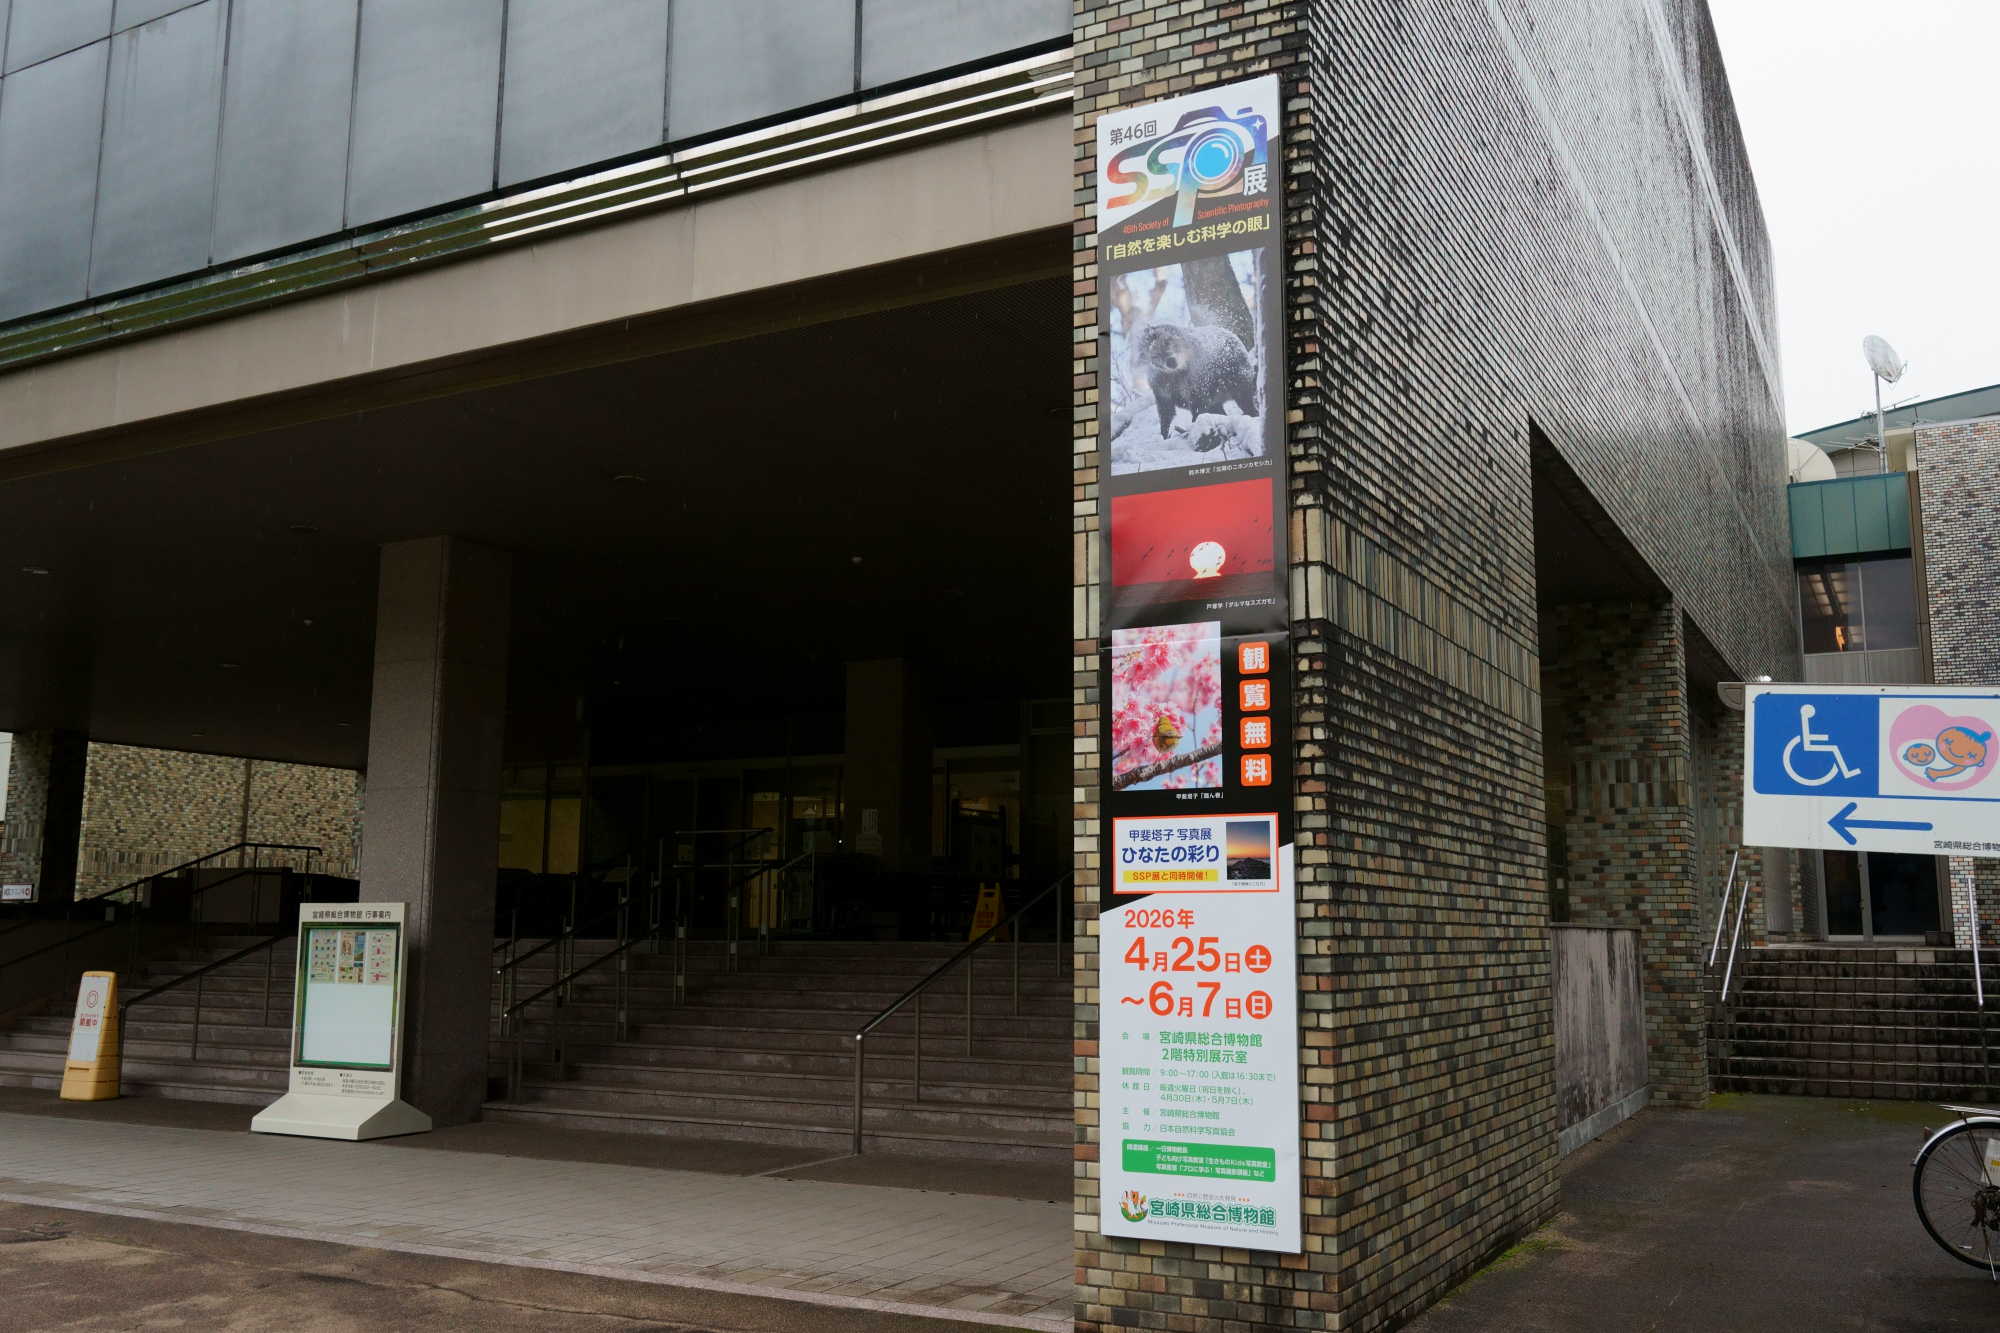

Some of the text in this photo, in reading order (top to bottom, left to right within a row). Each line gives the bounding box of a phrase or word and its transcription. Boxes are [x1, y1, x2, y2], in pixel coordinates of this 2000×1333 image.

[1110, 120, 1157, 146] 第46回
[1106, 214, 1270, 260] 「自然を楽しむ科学の眼」
[1243, 647, 1266, 782] 観覧無料
[1129, 828, 1212, 842] 甲斐塔子 写真展
[1122, 845, 1220, 863] ひなたの彩り
[1133, 870, 1208, 881] SSP展と同時開催！
[1124, 909, 1195, 929] 2026年
[1159, 1031, 1263, 1048] 宮崎県総合博物館
[1162, 1048, 1248, 1064] 2階特別展示室
[1150, 1200, 1275, 1227] 宮崎県総合博物館
